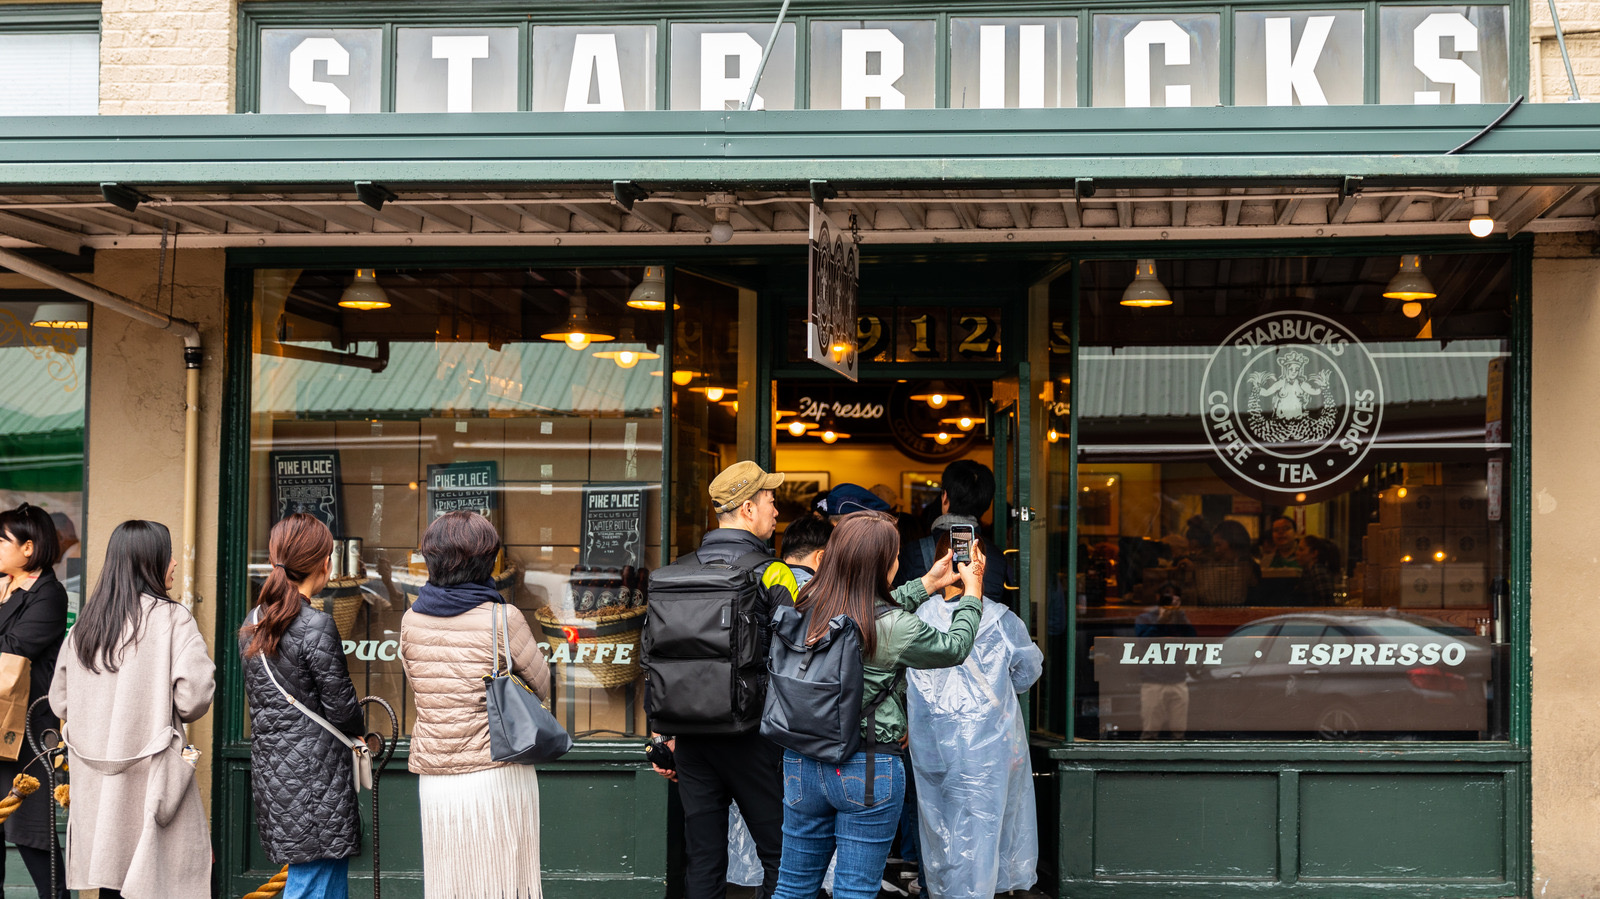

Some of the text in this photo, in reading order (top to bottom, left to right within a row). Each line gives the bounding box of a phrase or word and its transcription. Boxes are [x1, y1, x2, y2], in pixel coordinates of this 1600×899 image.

[289, 13, 1481, 113] STARBUCKS
[802, 314, 991, 353] 912
[1234, 319, 1350, 357] STARBUCKS
[799, 396, 885, 422] Espresso
[1207, 390, 1253, 466] COFFEE
[1339, 388, 1375, 456] SPICES
[278, 460, 333, 475] PIKE PLACE
[1277, 462, 1318, 484] TEA
[434, 471, 489, 489] PIKE PLACE
[434, 489, 489, 498] EXCLUSIVE
[438, 500, 458, 511] PIKE
[457, 498, 485, 510] PLACE
[588, 493, 640, 509] PIKE PLACE
[588, 511, 639, 519] EXCLUSIVE
[592, 520, 636, 531] WATER BOTTLE
[1119, 642, 1467, 666] LATTE ESPRESSO
